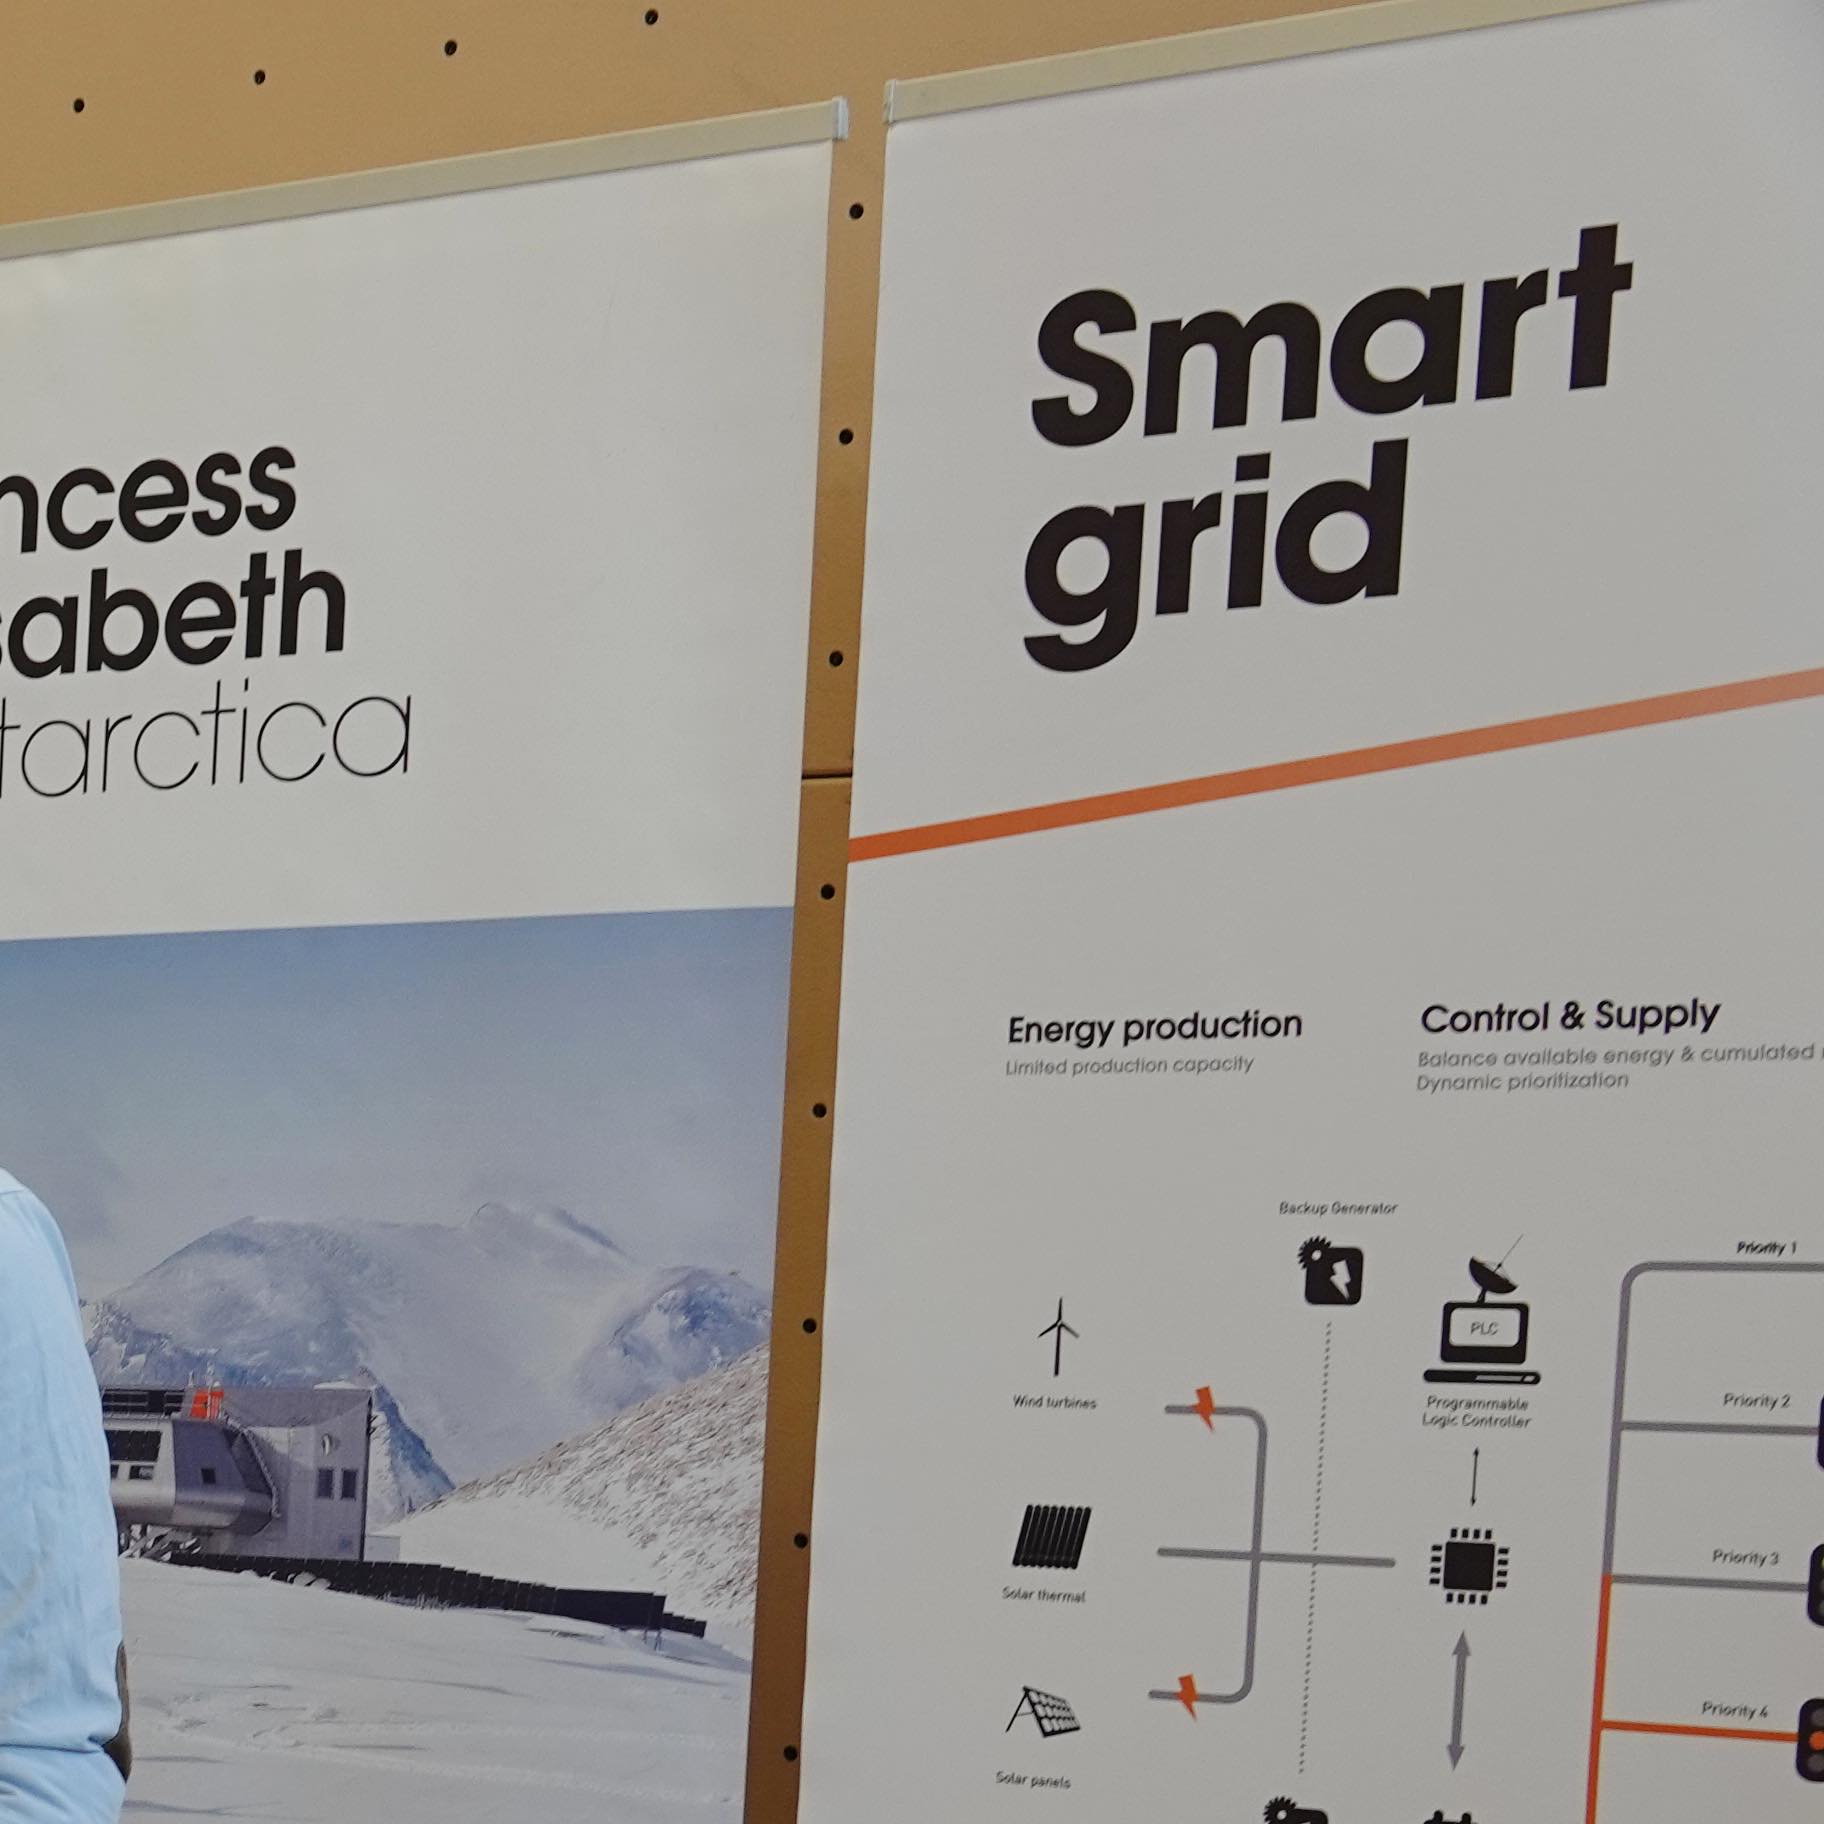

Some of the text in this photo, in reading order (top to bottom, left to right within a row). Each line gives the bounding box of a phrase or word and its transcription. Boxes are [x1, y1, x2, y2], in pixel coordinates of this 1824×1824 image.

[1031, 223, 1634, 483] Smart
[1023, 437, 1409, 673] grid
[1420, 996, 1722, 1036] Control & Supply
[1007, 1009, 1303, 1050] Energy production
[1417, 1042, 1816, 1069] Balance available energy & cumulated
[1005, 1055, 1255, 1079] Limited production capacity
[1415, 1071, 1630, 1096] Dynamic prioritization
[1279, 1200, 1399, 1219] Backup Generator
[1735, 1240, 1788, 1258] Priority
[1470, 1320, 1499, 1336] PLC
[1012, 1394, 1098, 1410] Wind turbines
[1425, 1394, 1530, 1414] Programmable
[1722, 1392, 1779, 1412] Priority
[1421, 1411, 1533, 1430] Logic Controller
[1711, 1548, 1769, 1569] Priority
[1001, 1585, 1087, 1604] Solar thermal
[1701, 1700, 1758, 1722] Priority
[995, 1770, 1072, 1790] Solar panels
